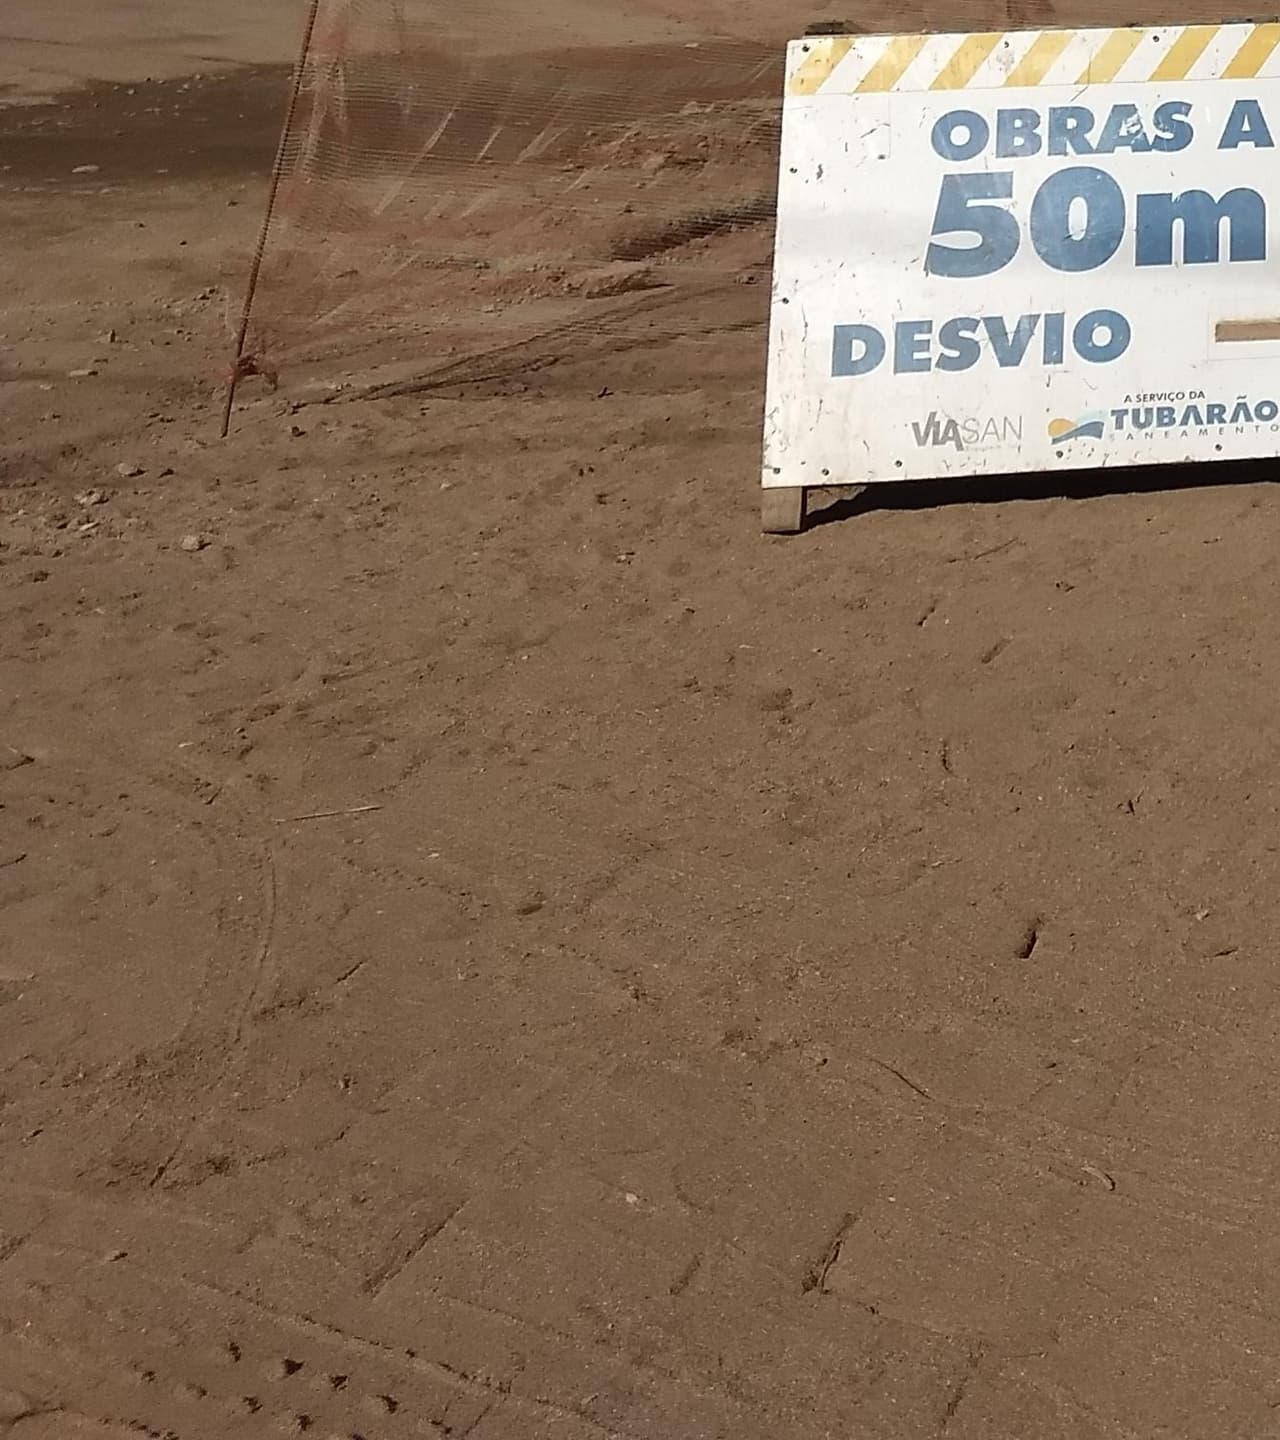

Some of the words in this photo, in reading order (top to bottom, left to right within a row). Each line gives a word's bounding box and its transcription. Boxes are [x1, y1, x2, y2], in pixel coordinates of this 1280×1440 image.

[931, 101, 1194, 161] OBRAS
[1218, 99, 1275, 150] A
[924, 165, 1267, 279] 50m
[831, 309, 1133, 378] DESVIO
[1109, 393, 1280, 431] TUBARÃO
[1123, 393, 1133, 404] A
[1134, 391, 1186, 404] SERVIÇO
[1188, 389, 1206, 401] DA
[911, 410, 1024, 452] VIASAN
[1109, 422, 1280, 443] SANEAMENTO
